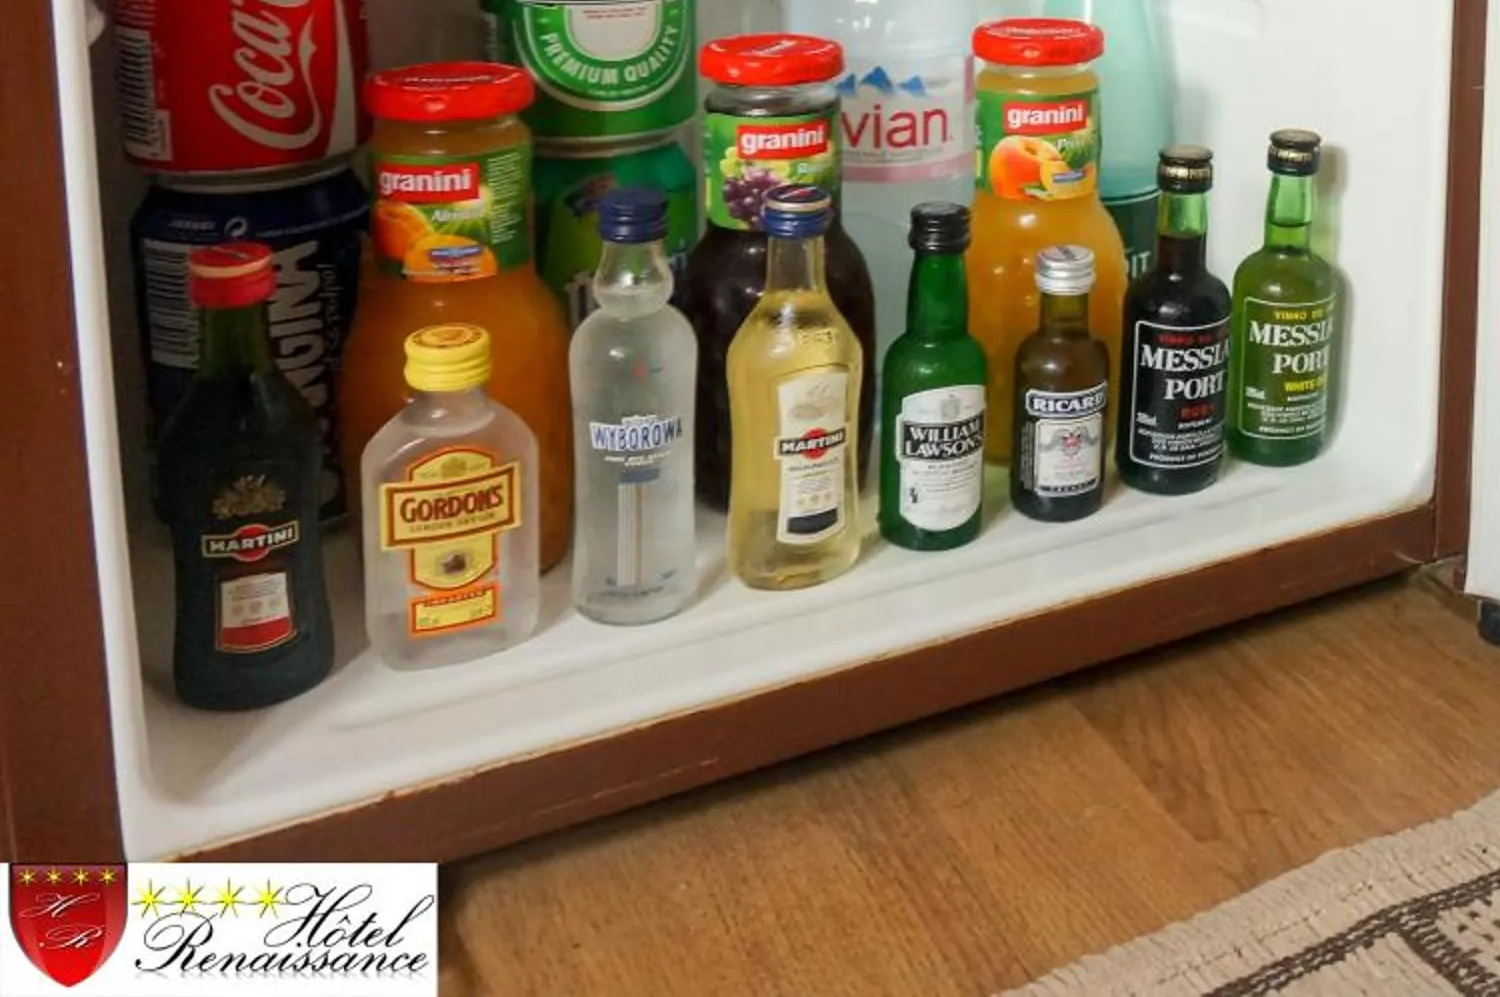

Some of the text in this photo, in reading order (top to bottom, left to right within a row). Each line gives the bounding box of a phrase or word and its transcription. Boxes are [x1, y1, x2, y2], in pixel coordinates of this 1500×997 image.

[841, 104, 948, 149] vian
[1008, 105, 1083, 128] granini
[741, 126, 825, 154] granini
[379, 169, 471, 195] granini
[782, 430, 845, 453] MARTINI
[209, 527, 294, 552] MARTINI
